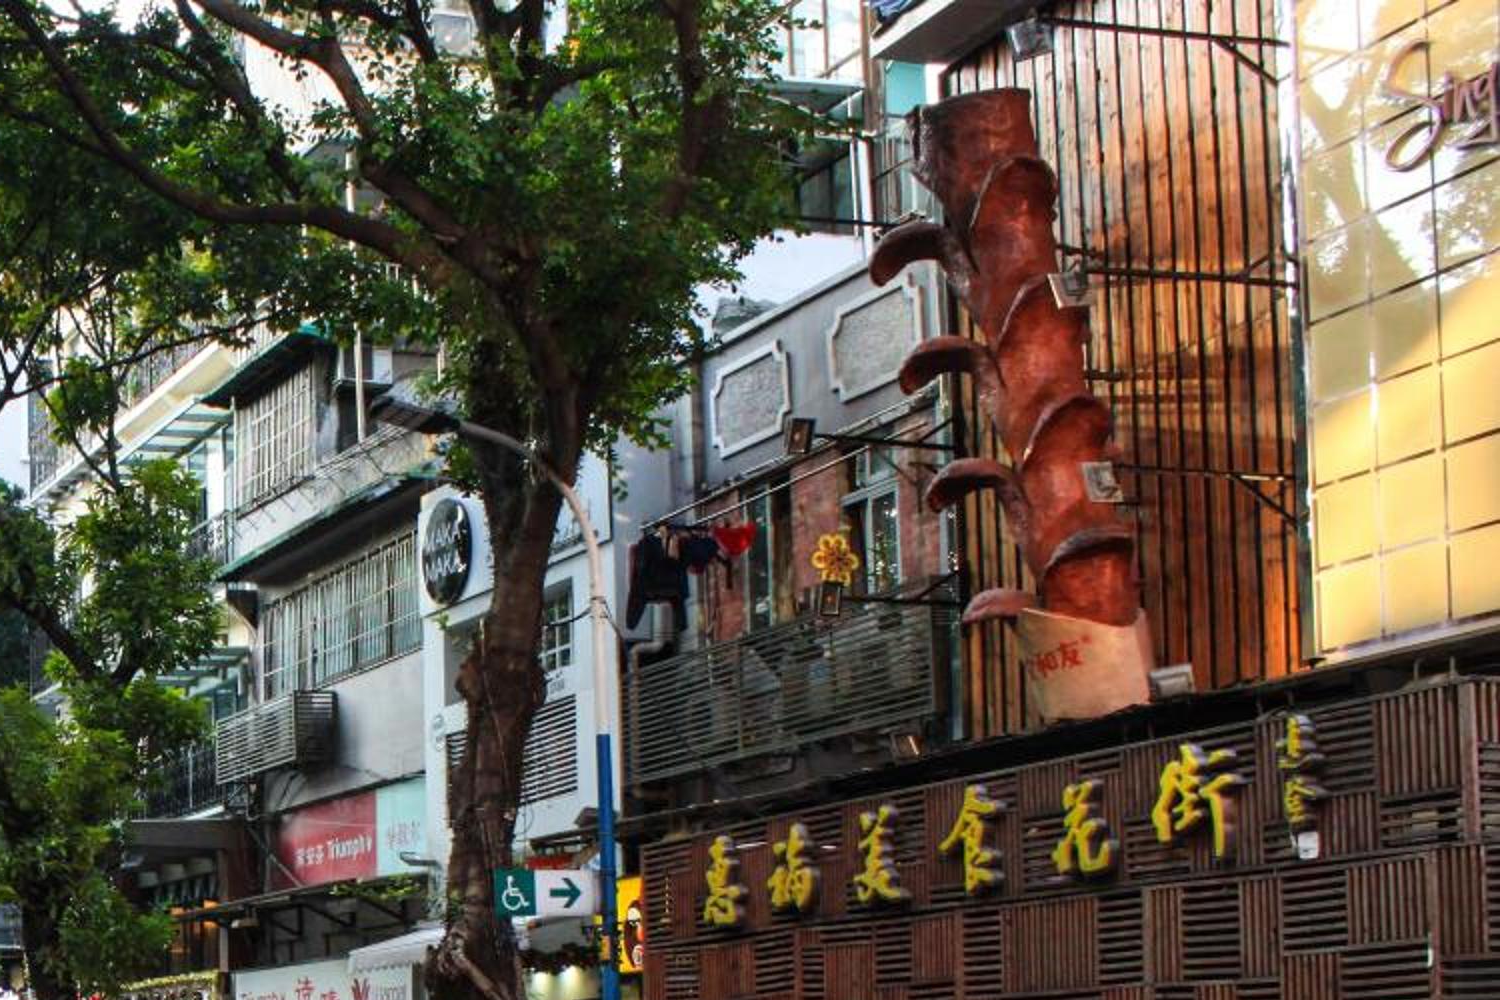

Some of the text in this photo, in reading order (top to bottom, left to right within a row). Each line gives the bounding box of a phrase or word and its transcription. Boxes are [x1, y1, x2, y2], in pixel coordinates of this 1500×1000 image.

[703, 743, 1241, 925] 惠福美食花街
